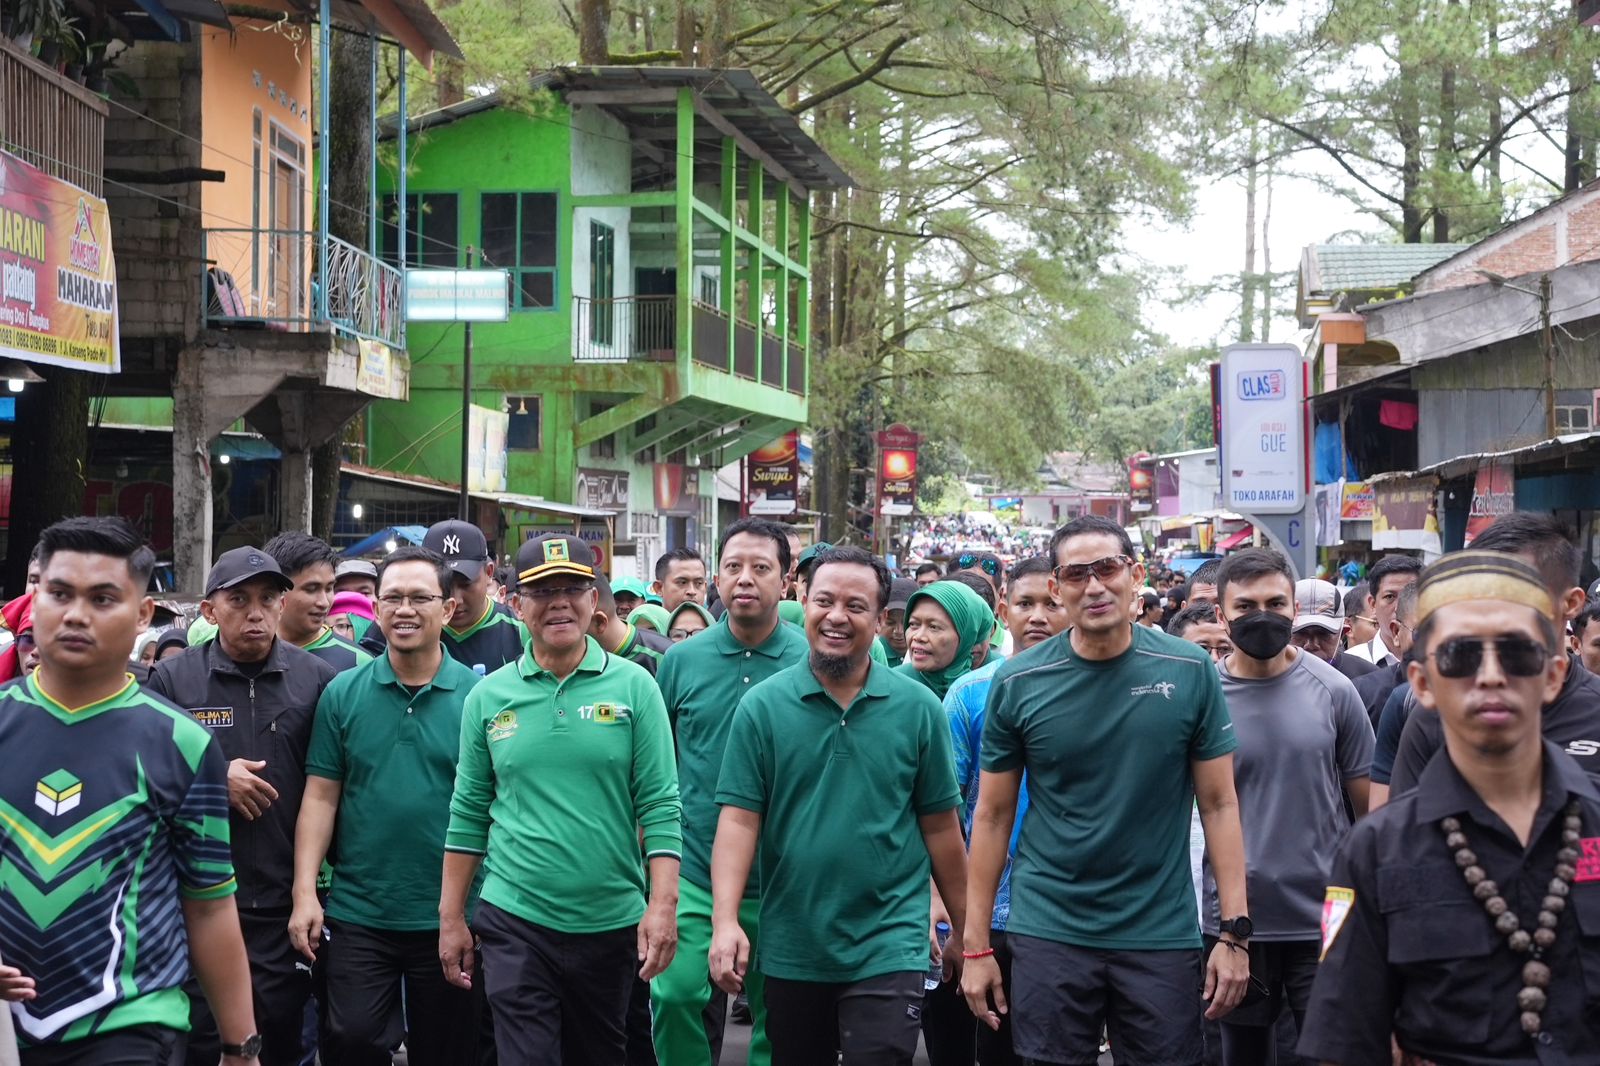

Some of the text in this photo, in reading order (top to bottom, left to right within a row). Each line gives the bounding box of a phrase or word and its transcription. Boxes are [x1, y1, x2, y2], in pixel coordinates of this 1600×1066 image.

[1242, 375, 1271, 397] CLAS
[1261, 434, 1287, 453] GUE
[753, 467, 794, 486] Surya
[1233, 490, 1295, 501] TOKO ARAFAH
[443, 534, 460, 554] NY
[577, 705, 594, 719] 17
